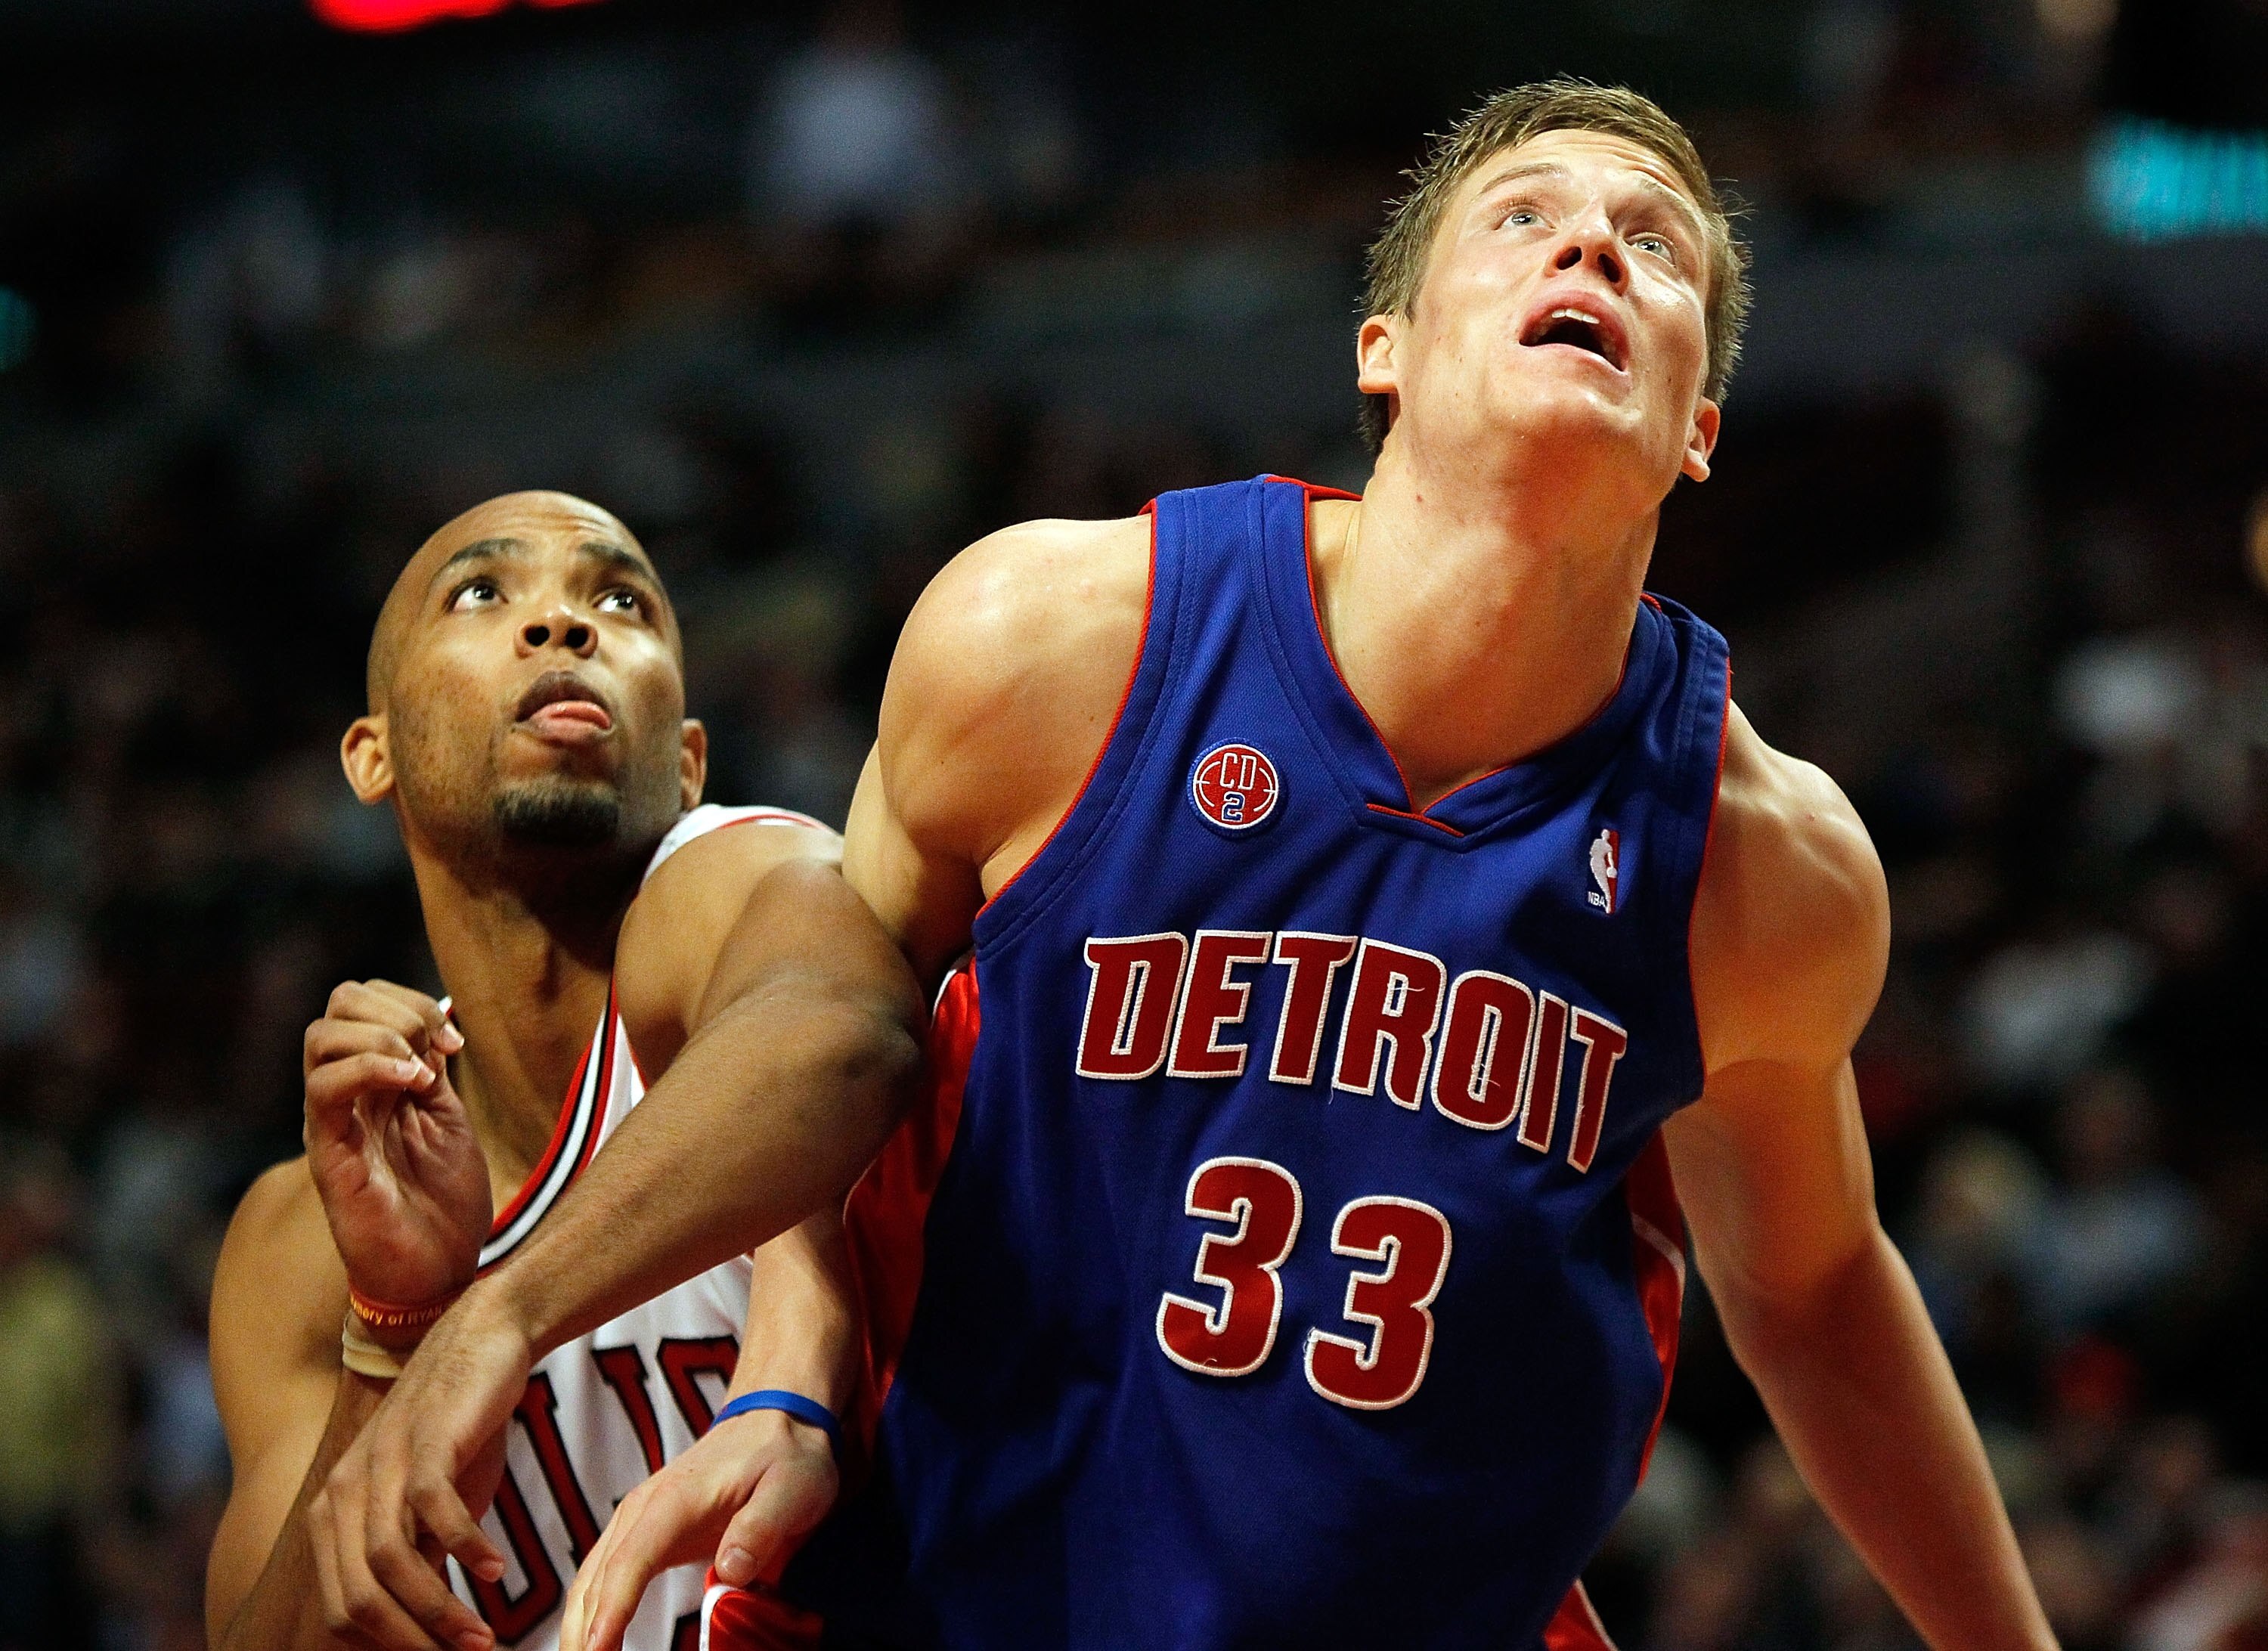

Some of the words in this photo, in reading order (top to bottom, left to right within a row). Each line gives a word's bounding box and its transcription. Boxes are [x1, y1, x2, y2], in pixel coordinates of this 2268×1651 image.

[1219, 752, 1256, 790] CD
[1221, 791, 1246, 822] 2
[1588, 891, 1606, 907] NBA
[1076, 929, 1628, 1174] DETROIT
[1155, 1156, 1452, 1411] 33
